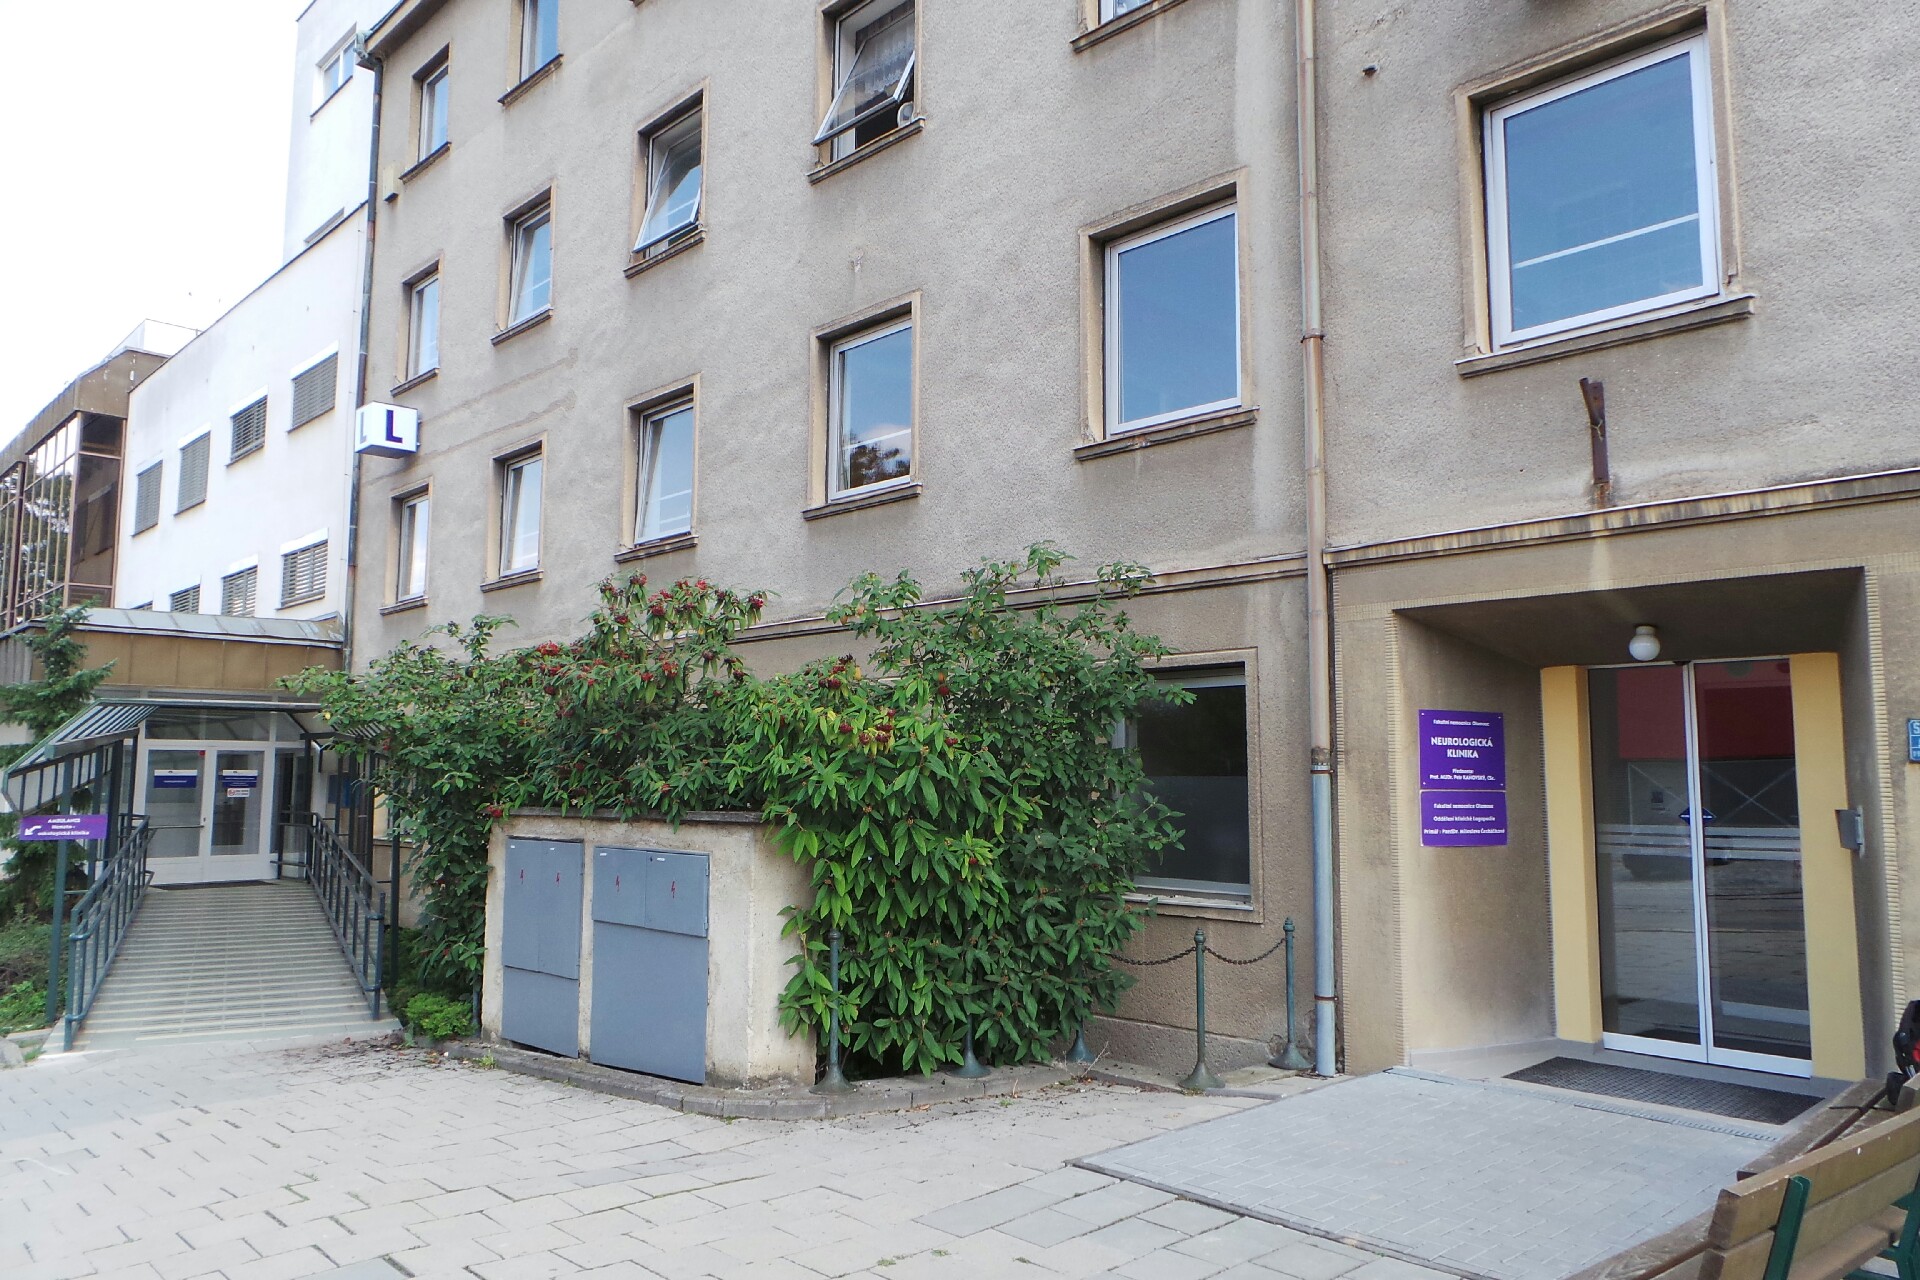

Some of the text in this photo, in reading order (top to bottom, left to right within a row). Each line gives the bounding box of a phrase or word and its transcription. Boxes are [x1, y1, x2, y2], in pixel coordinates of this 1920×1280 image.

[359, 411, 367, 444] L
[385, 409, 403, 443] L
[1430, 736, 1493, 747] NEUROLOGICKÁ
[1447, 748, 1479, 758] KLINIKA
